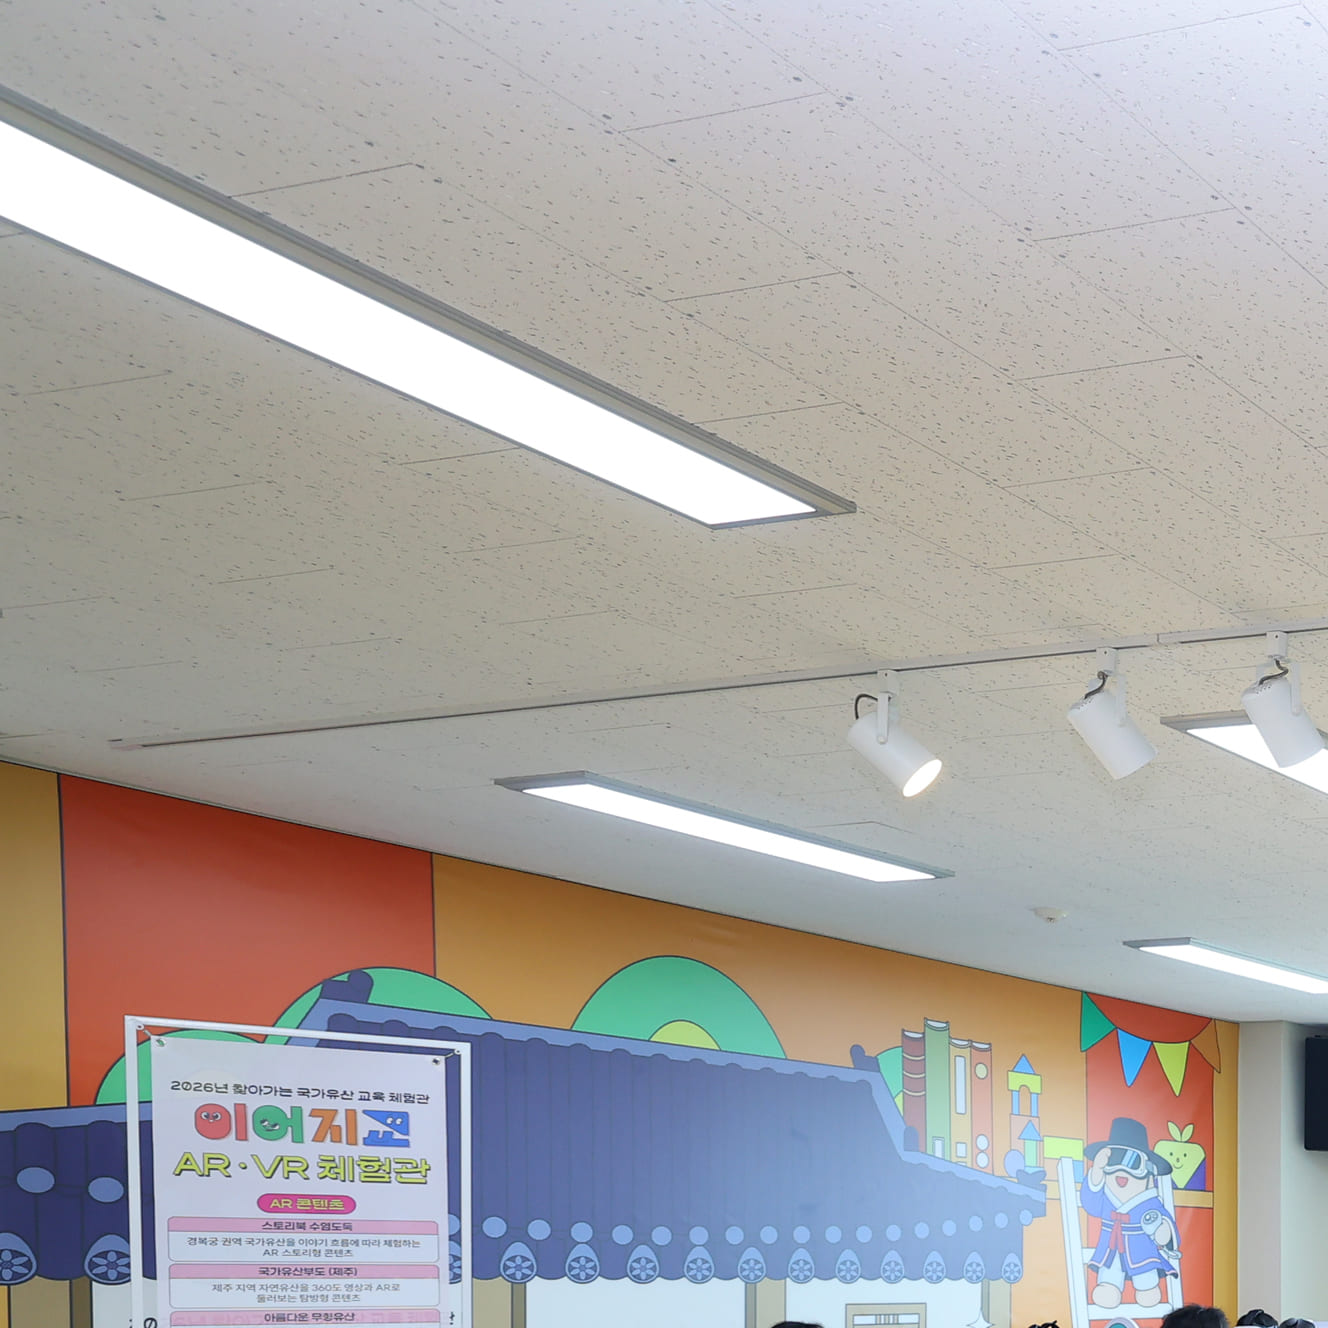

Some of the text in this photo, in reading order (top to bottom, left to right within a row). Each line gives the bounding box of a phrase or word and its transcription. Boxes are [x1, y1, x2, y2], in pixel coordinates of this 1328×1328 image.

[171, 1080, 430, 1105] 2026년 찾아가는 국가유산 교육 체험관
[194, 1102, 410, 1148] 이어지교
[317, 1154, 431, 1185] 체험관
[269, 1198, 345, 1211] AR 콘텐츠
[261, 1221, 306, 1231] 스토리북
[187, 1236, 421, 1248] 경복궁 권역 국가유산을 이야기 흐름에 따라 체험하는
[262, 1249, 353, 1258] AR 스토리형 콘텐츠
[328, 1267, 358, 1277] (제주)
[211, 1283, 400, 1293] 제주 지역 자연유산을 360도 영상과 AR로
[256, 1294, 297, 1304] 둘러보는
[331, 1294, 361, 1303] 콘텐츠
[264, 1312, 356, 1322] 아름다운 무형유산
